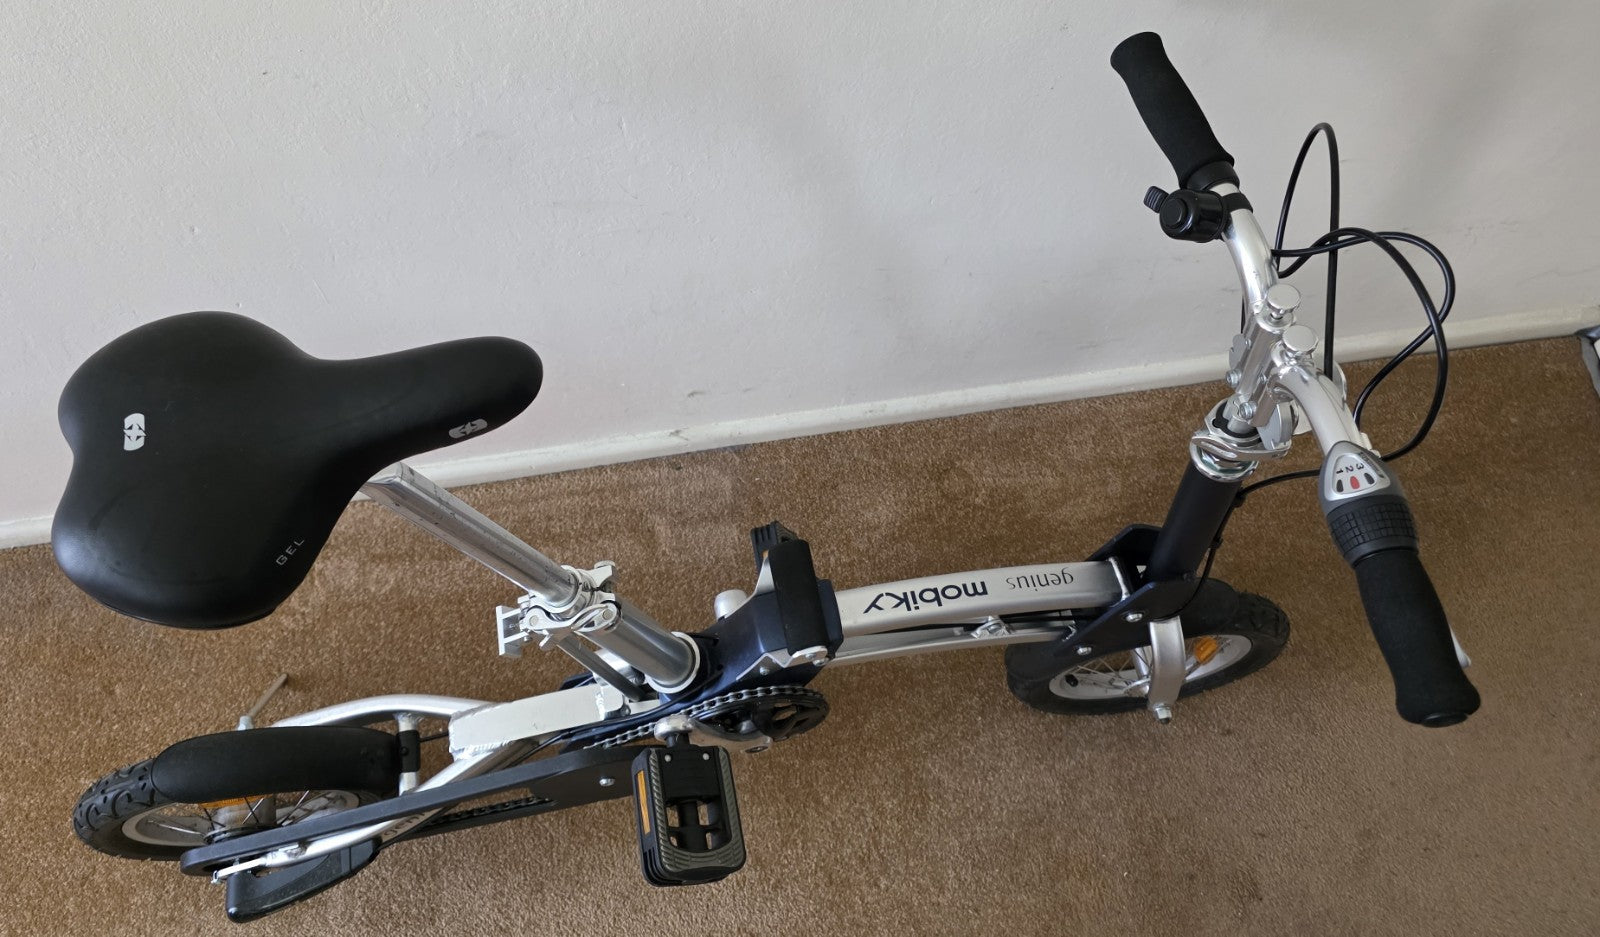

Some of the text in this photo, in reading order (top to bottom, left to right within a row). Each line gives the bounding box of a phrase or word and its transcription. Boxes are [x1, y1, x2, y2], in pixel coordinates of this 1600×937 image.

[1345, 465, 1354, 473] 2
[1355, 462, 1365, 470] 3
[275, 539, 305, 566] GEL
[862, 566, 1075, 615] genius mobiky
